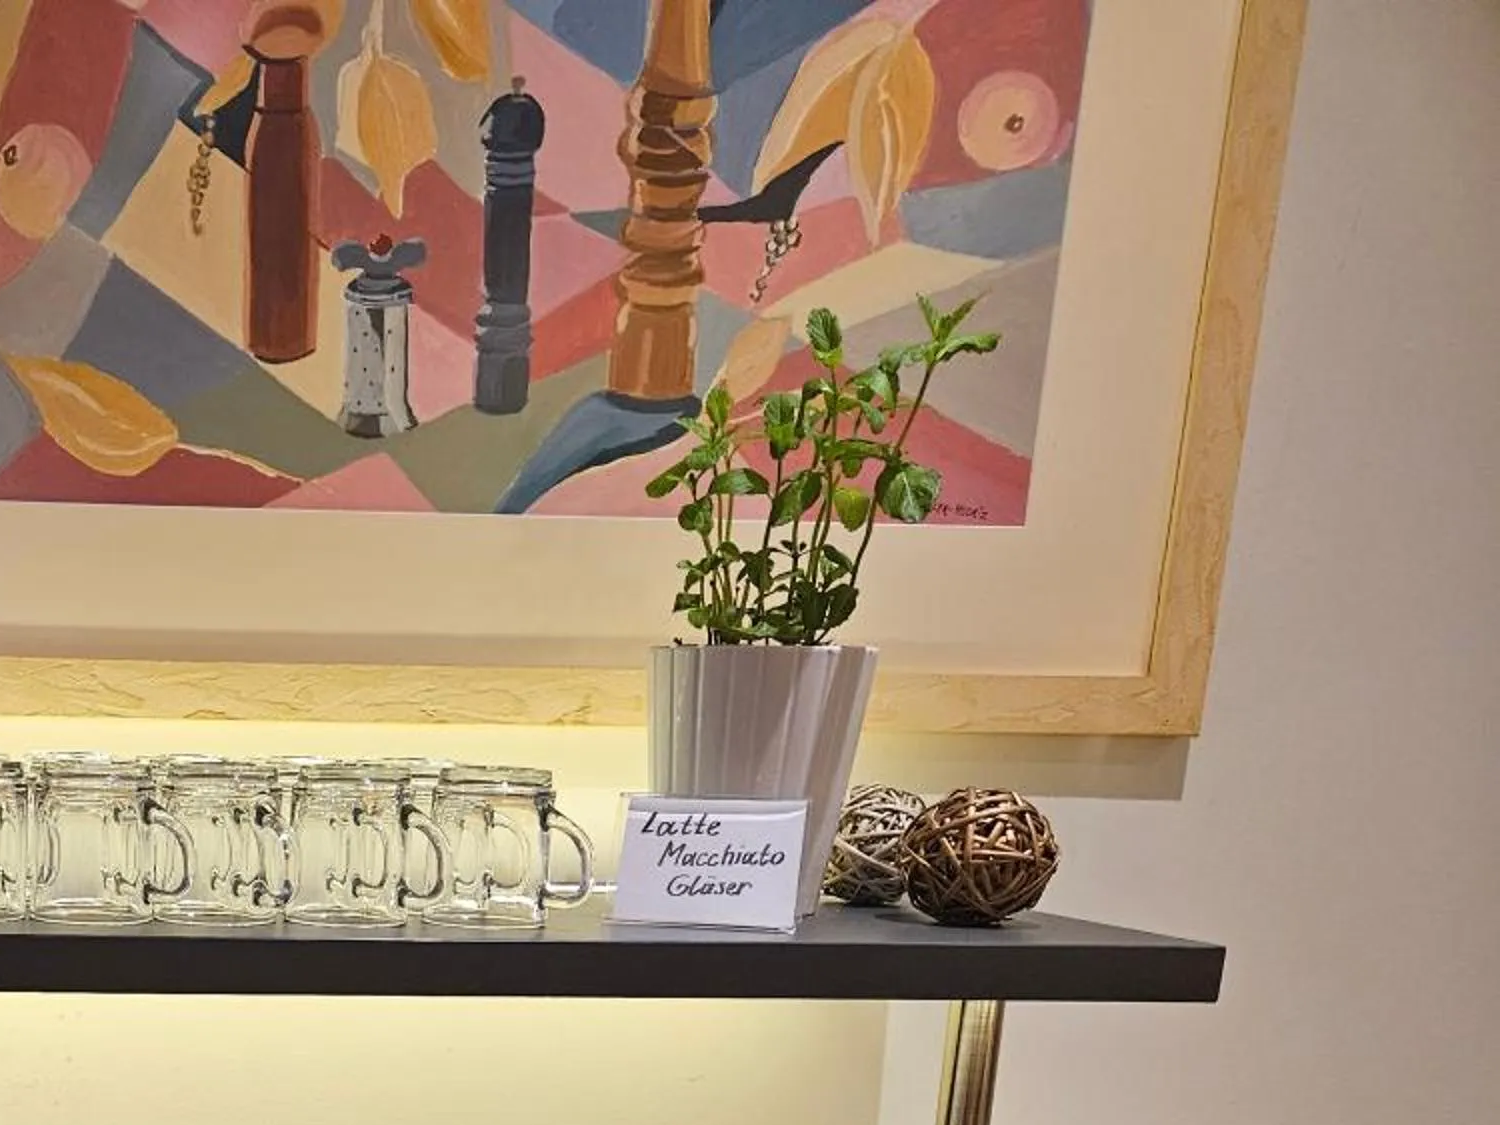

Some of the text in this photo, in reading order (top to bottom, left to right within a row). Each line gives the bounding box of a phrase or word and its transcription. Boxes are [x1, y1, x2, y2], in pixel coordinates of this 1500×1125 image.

[641, 811, 721, 837] Latte
[657, 840, 785, 867] Macchiato
[667, 873, 752, 897] Gläser
